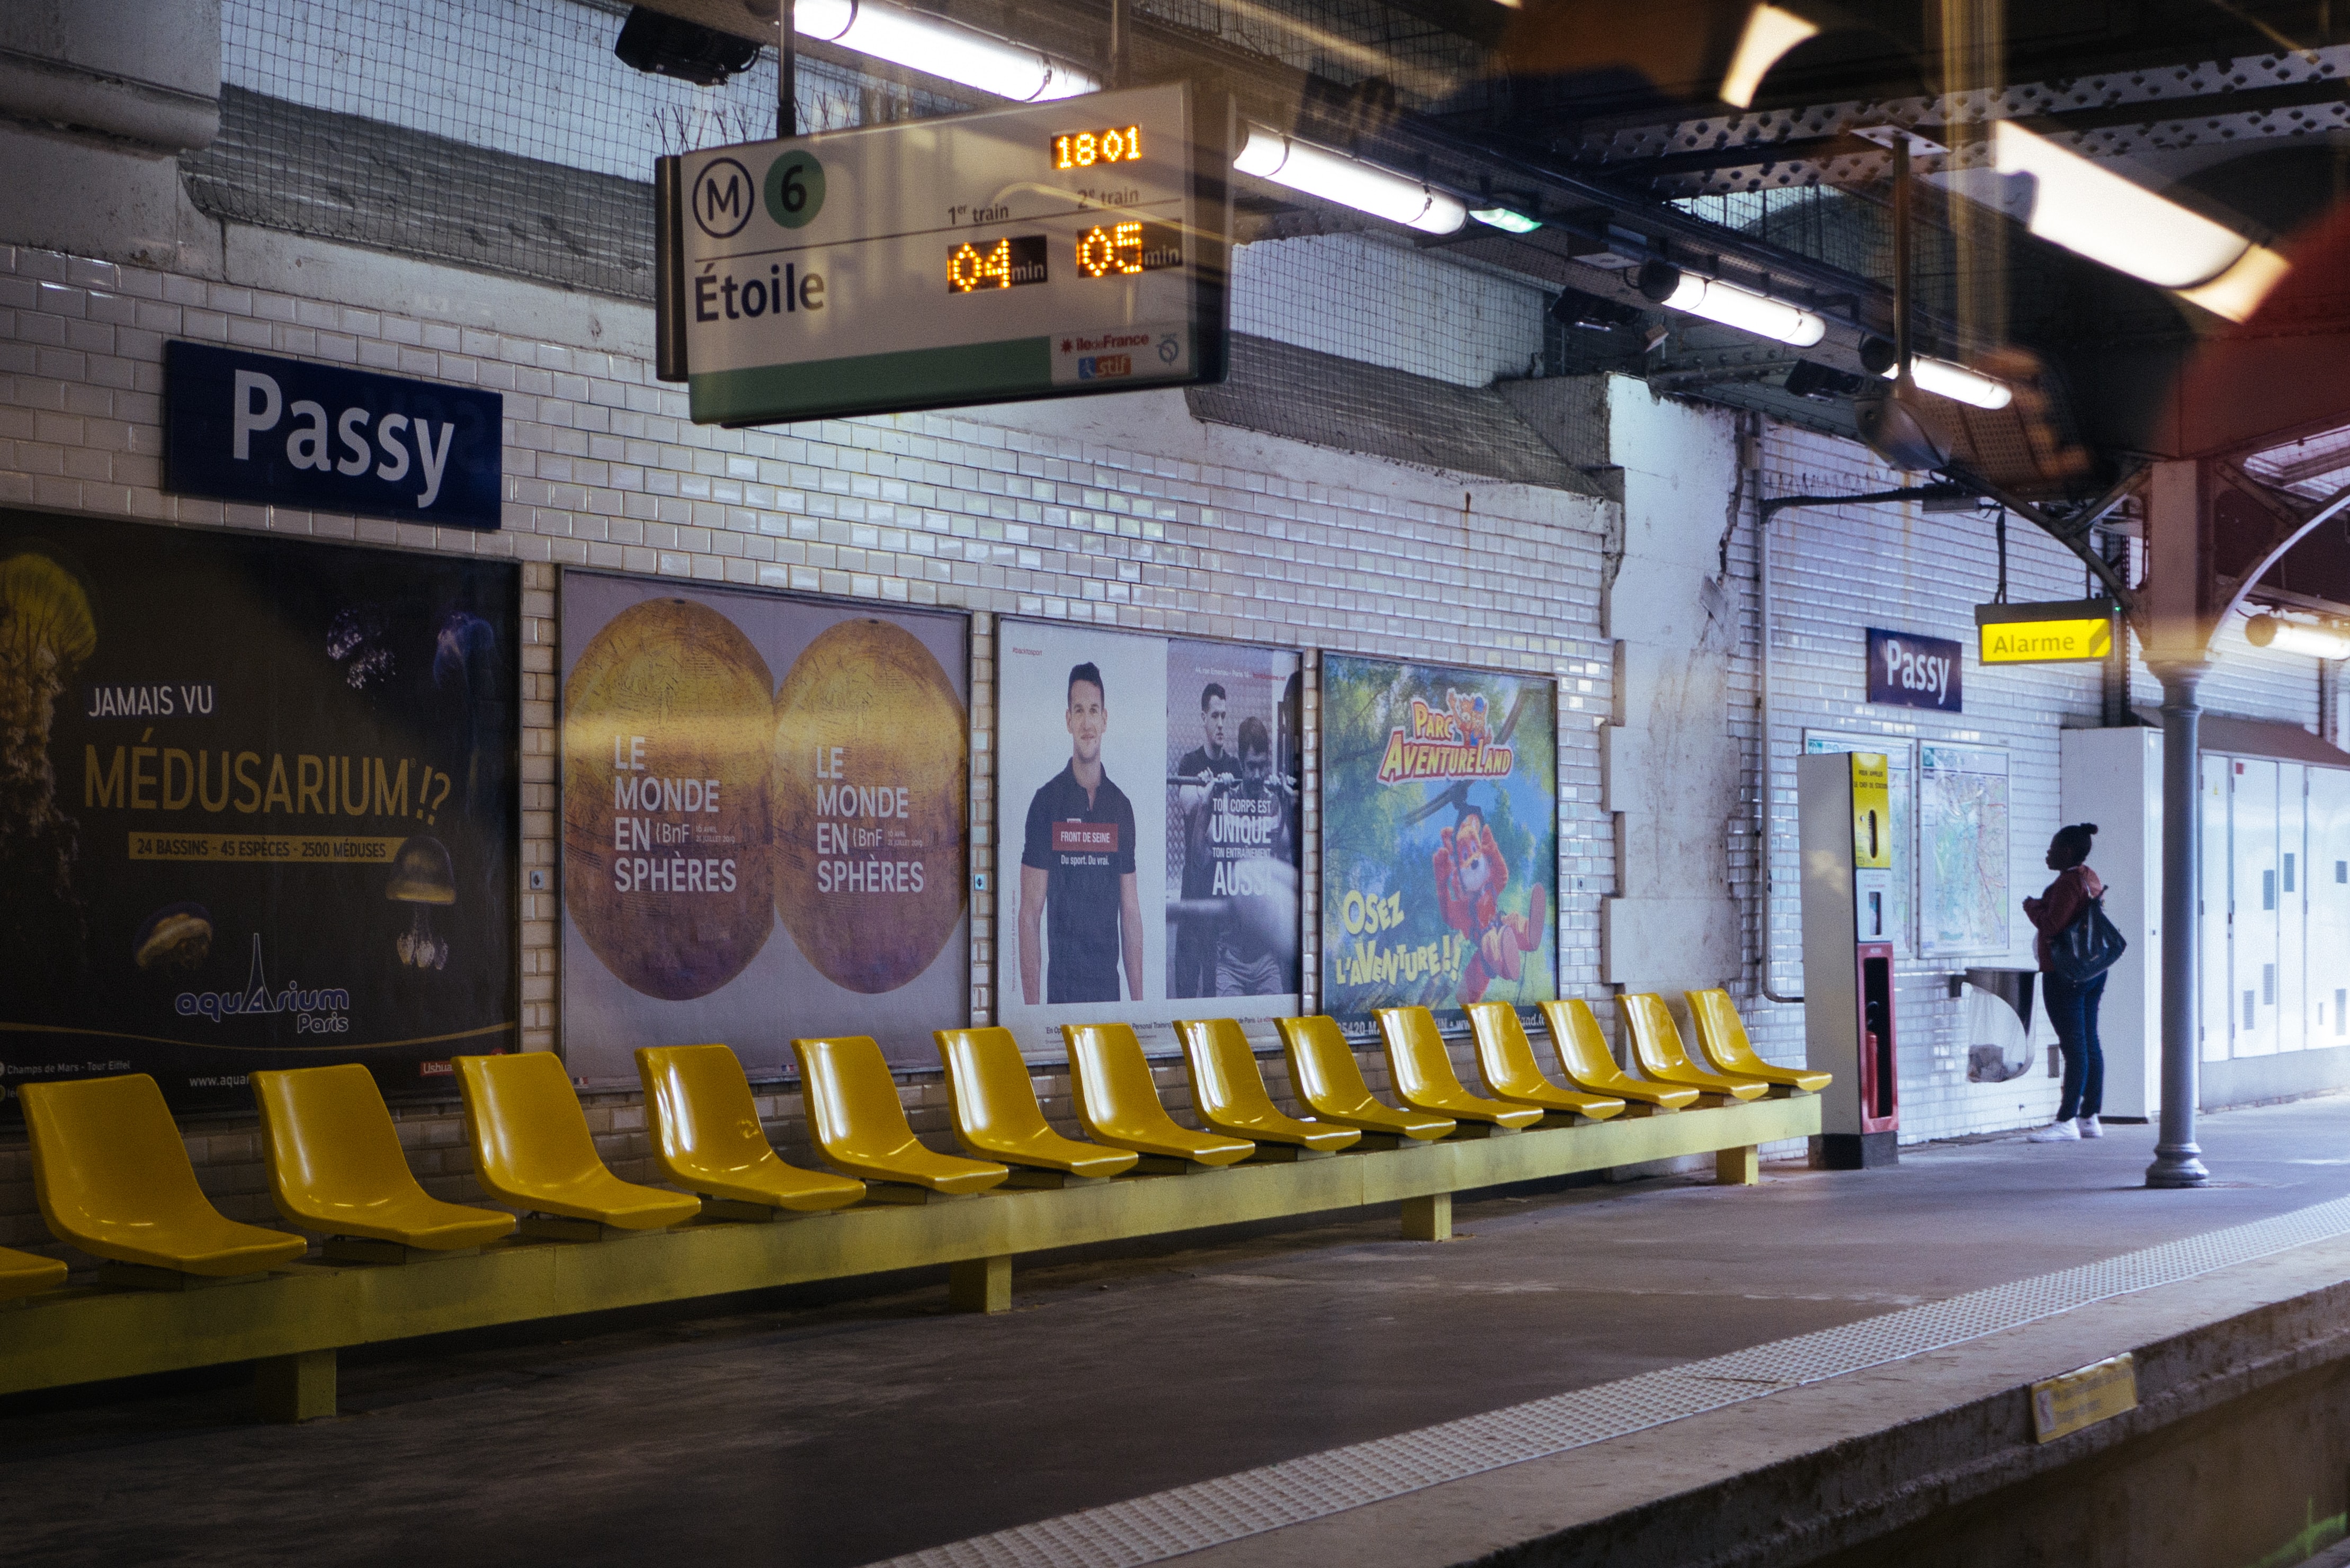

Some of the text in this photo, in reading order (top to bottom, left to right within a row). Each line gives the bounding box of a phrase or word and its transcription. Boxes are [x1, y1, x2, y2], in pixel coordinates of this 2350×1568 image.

[781, 164, 807, 212] 6
[1101, 185, 1140, 205] train
[973, 203, 1009, 223] train
[1082, 221, 1181, 276] 05 min
[951, 238, 1044, 292] 04 min
[695, 262, 824, 322] Étoile
[234, 369, 454, 508] Passy
[1994, 633, 2075, 654] Alarme
[1887, 640, 1950, 704] Passy
[88, 685, 213, 717] JAMAIS VU
[615, 736, 645, 770] LE
[817, 747, 843, 779] LE
[615, 776, 719, 813] MONDE
[816, 785, 908, 819] MONDE
[1230, 799, 1256, 813] CORPS
[1257, 800, 1271, 813] EST
[615, 818, 650, 851] EN
[817, 823, 848, 855] EN
[1061, 831, 1110, 843] FRONT DE SEINE
[1212, 814, 1272, 846] UNIQUE
[138, 840, 152, 855] 24
[156, 840, 209, 856] BASSINS
[221, 841, 234, 856] 45
[239, 838, 290, 857] ESPÈCES
[302, 842, 329, 857] 2500
[333, 838, 386, 858] MÉDUSES
[1061, 854, 1110, 867] Du sport. Du vrai.
[1212, 847, 1224, 858] TON
[615, 851, 737, 893] SPHÈRES
[817, 854, 924, 893] SPHÈRES
[297, 1011, 349, 1033] Paris
[7, 1064, 42, 1076] Champs
[44, 1063, 55, 1072] de
[58, 1062, 79, 1072] Mars
[87, 1062, 106, 1071] Tour
[108, 1061, 130, 1070] Eiffel
[424, 1063, 452, 1073] Ushua
